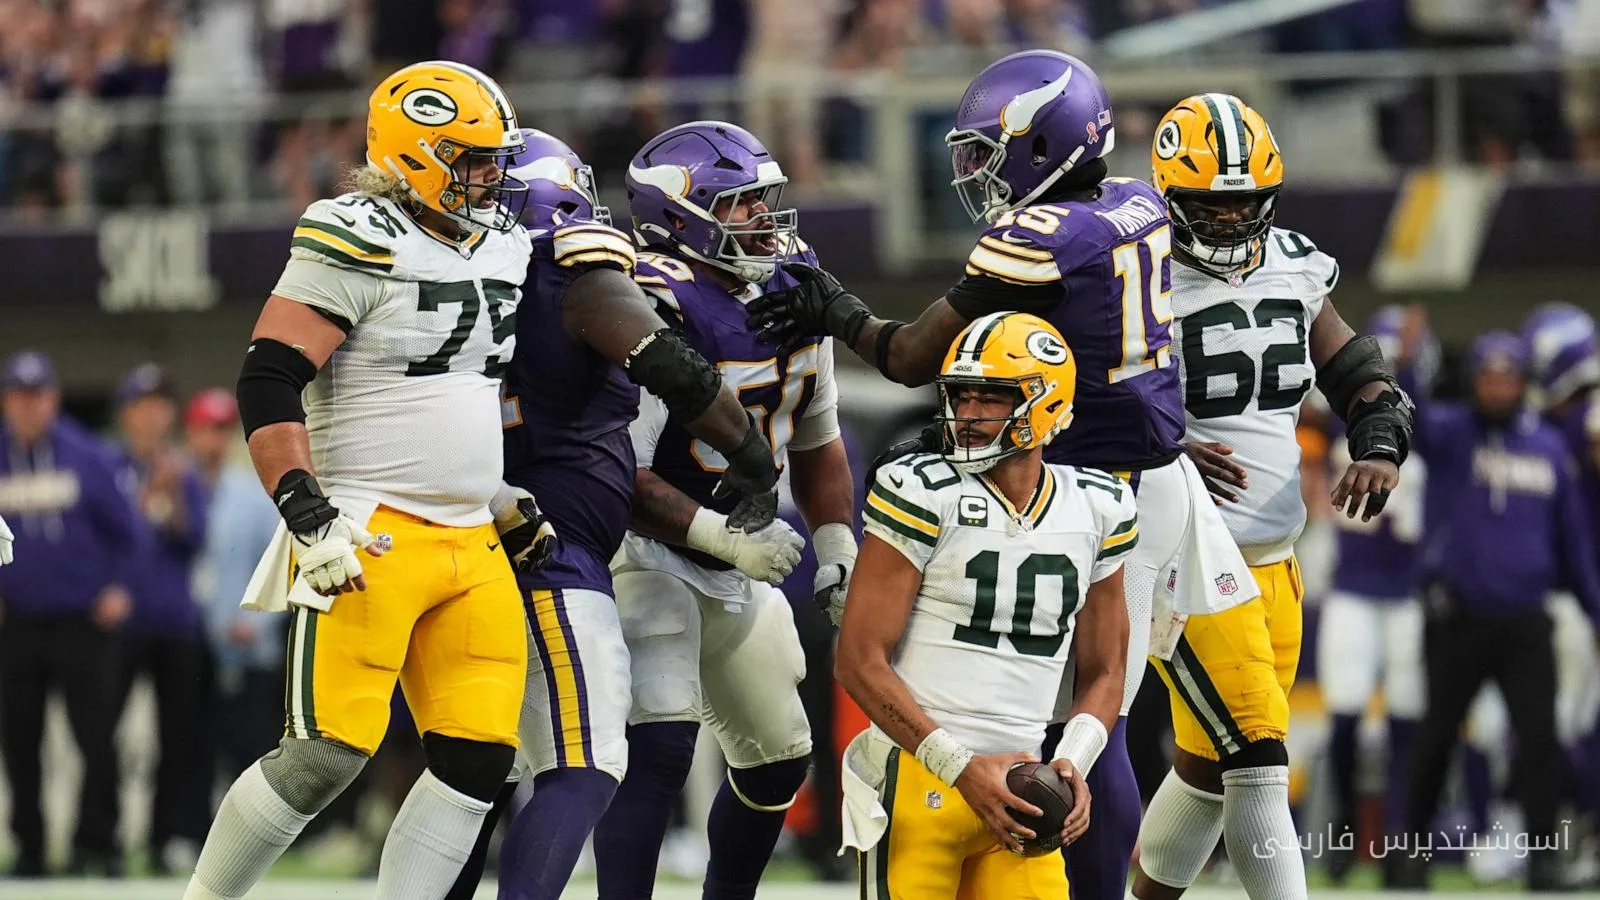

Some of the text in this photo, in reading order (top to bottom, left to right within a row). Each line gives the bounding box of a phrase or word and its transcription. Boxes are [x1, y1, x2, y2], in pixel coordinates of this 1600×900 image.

[1223, 178, 1245, 186] PACKERS
[1181, 298, 1312, 419] 62
[952, 550, 1079, 658] 10
